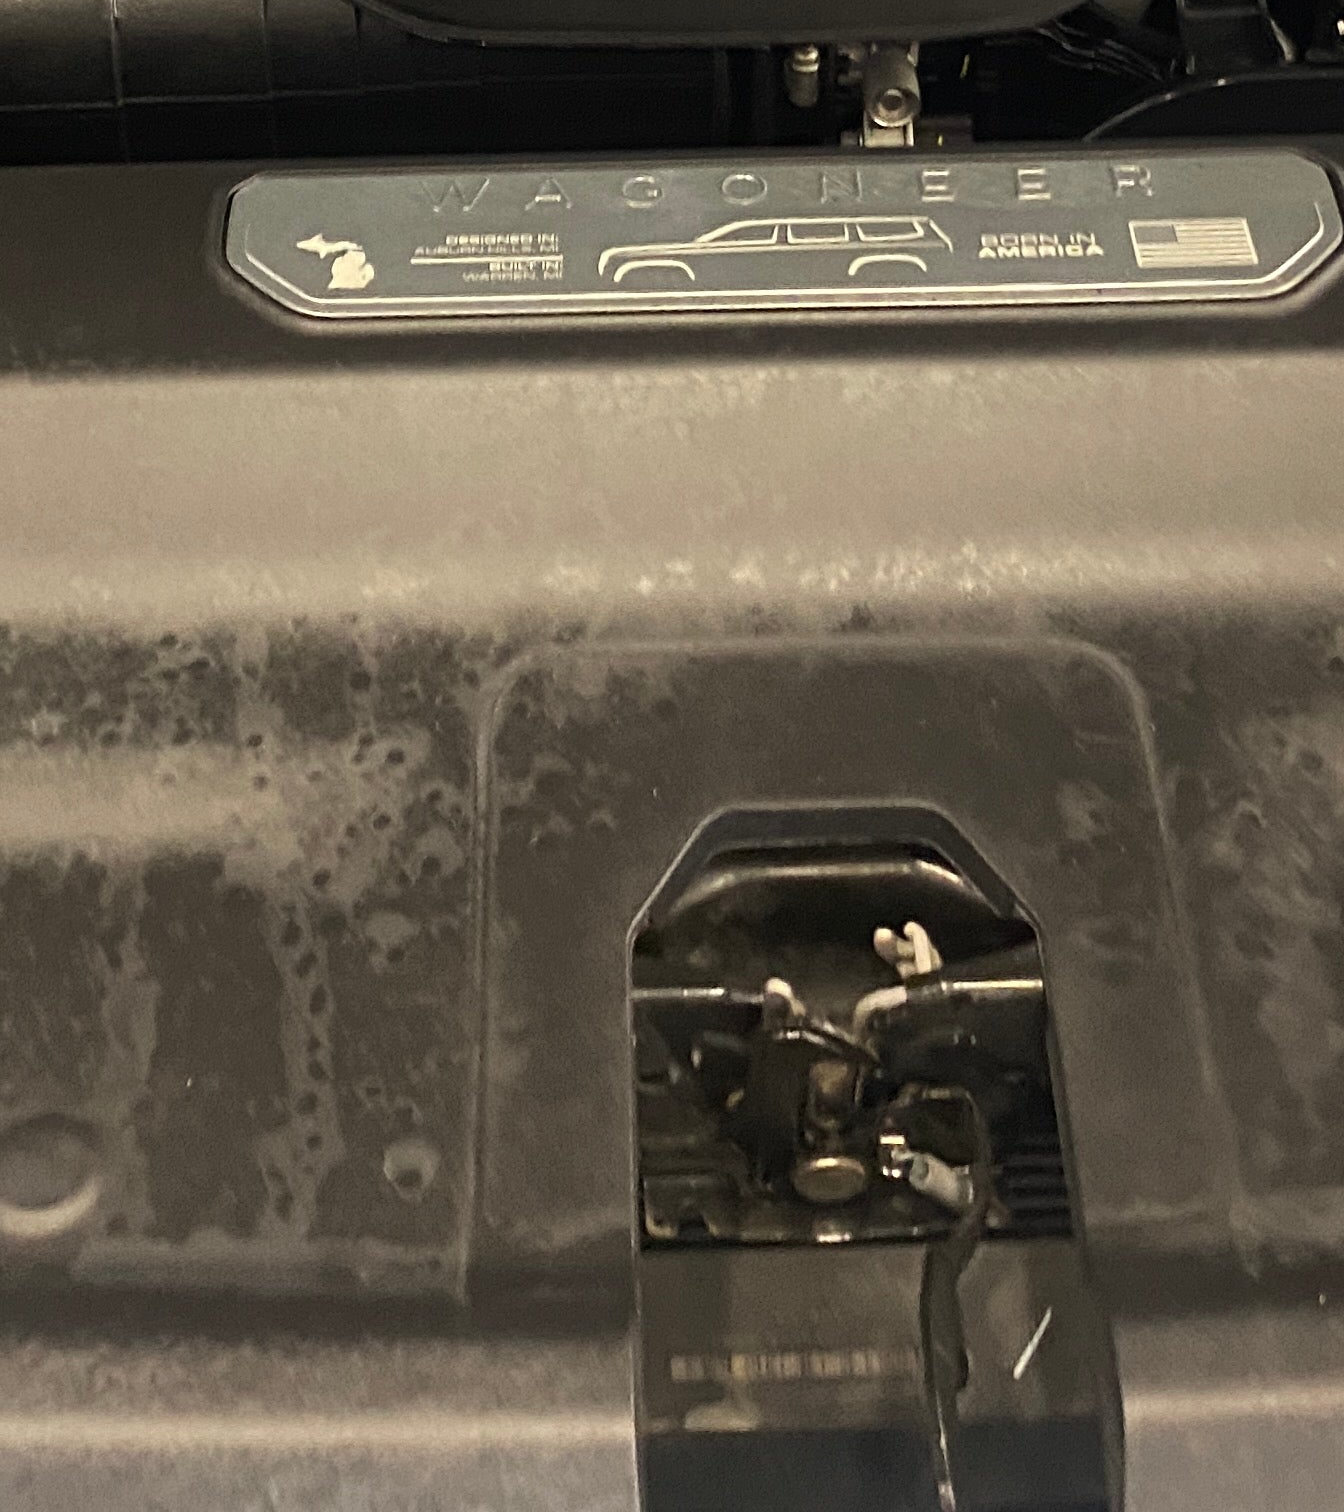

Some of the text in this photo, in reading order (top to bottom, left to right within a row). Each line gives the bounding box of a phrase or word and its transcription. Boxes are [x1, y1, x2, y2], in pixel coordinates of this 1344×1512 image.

[418, 164, 1153, 211] WAGONEER
[1070, 232, 1096, 246] IN
[979, 244, 1104, 258] AMERICA
